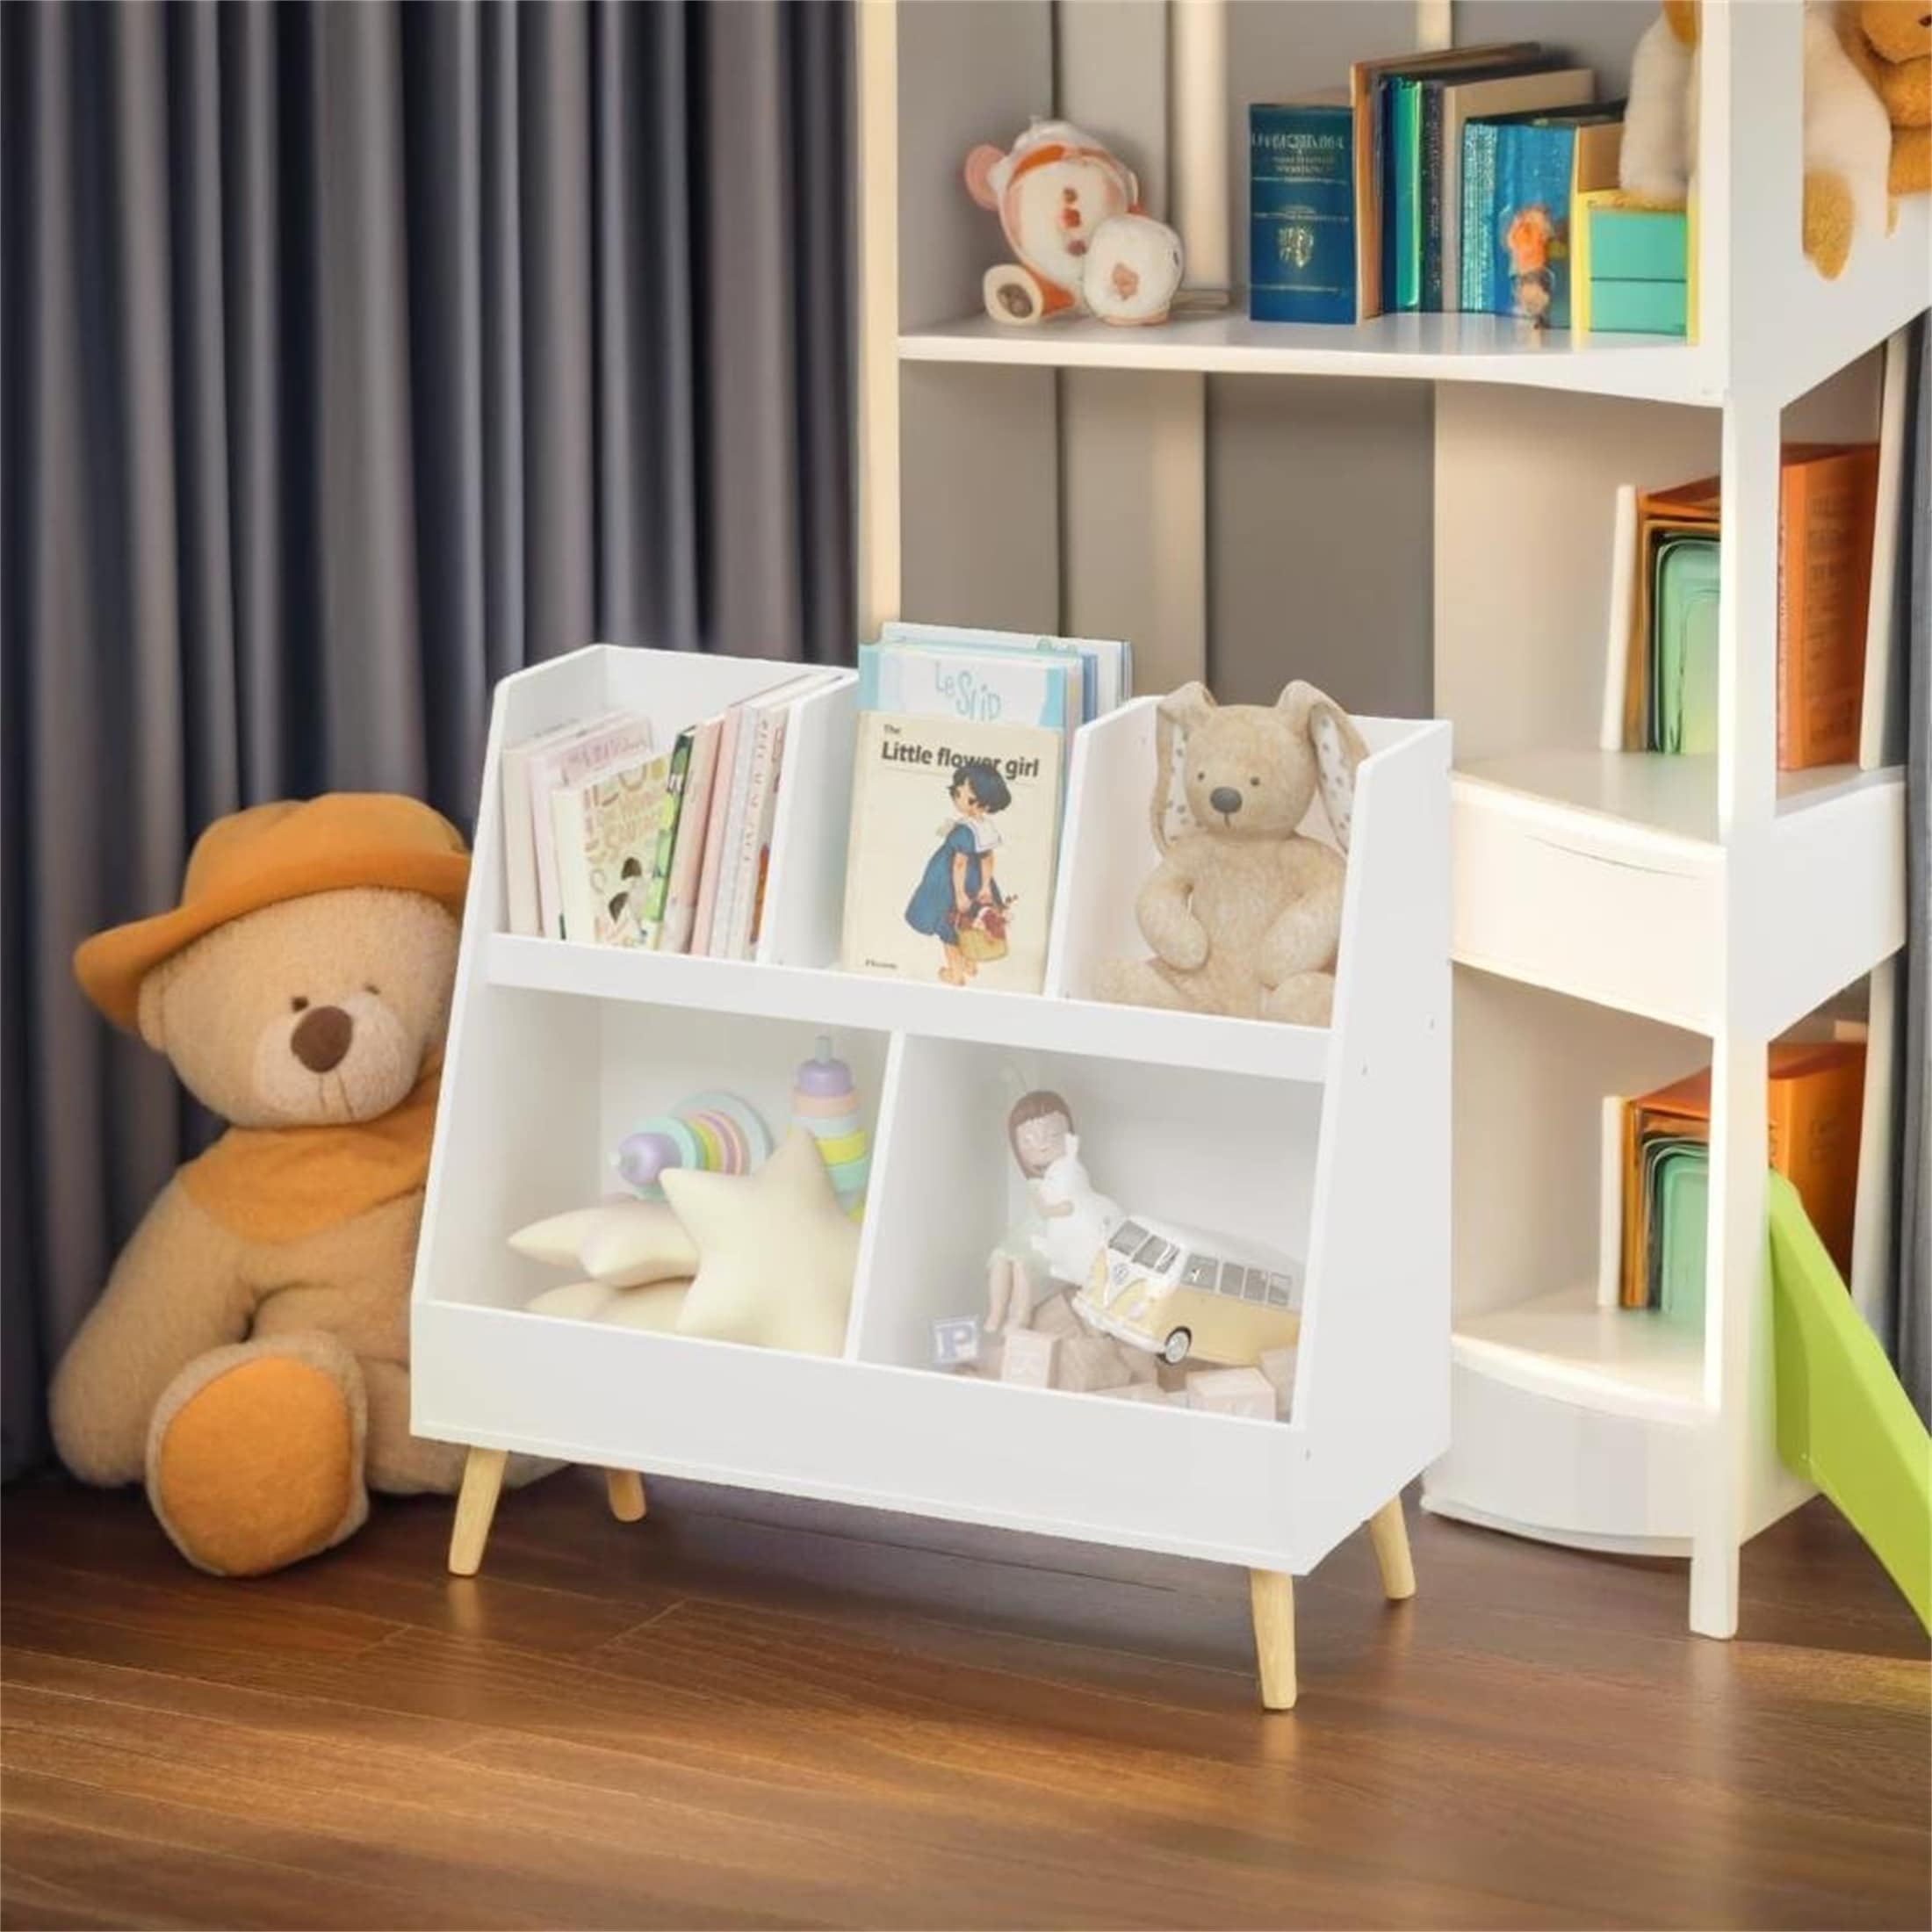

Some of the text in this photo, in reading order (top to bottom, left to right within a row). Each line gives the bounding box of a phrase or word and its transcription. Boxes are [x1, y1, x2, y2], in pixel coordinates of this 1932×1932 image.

[935, 660, 955, 699] Le
[883, 724, 901, 734] The
[882, 741, 934, 766] Little
[1006, 756, 1040, 781] girl
